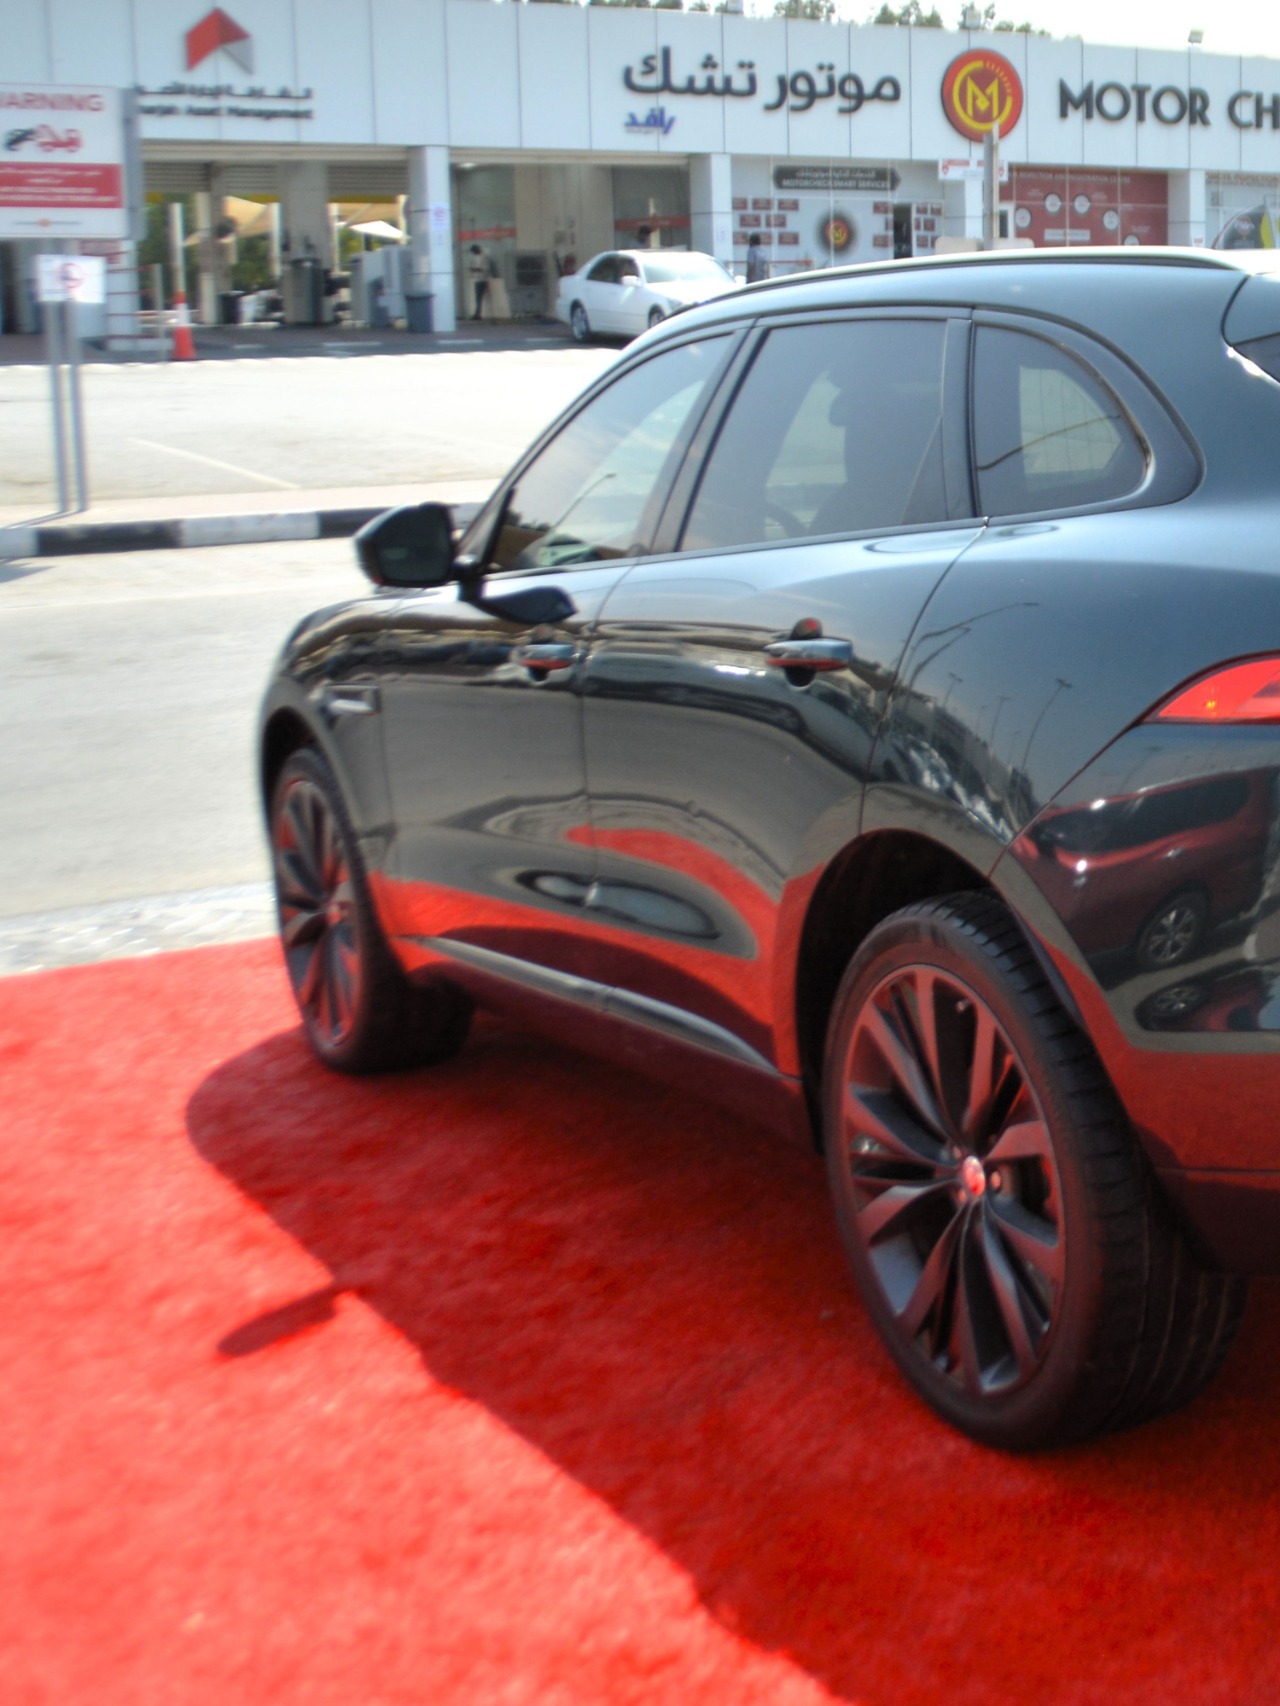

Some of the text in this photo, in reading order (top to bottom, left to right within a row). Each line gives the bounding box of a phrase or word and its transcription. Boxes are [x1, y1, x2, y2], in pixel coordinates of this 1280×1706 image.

[623, 46, 901, 114] موتور تشك
[1059, 78, 1211, 126] MOTOR
[227, 106, 313, 119] Management
